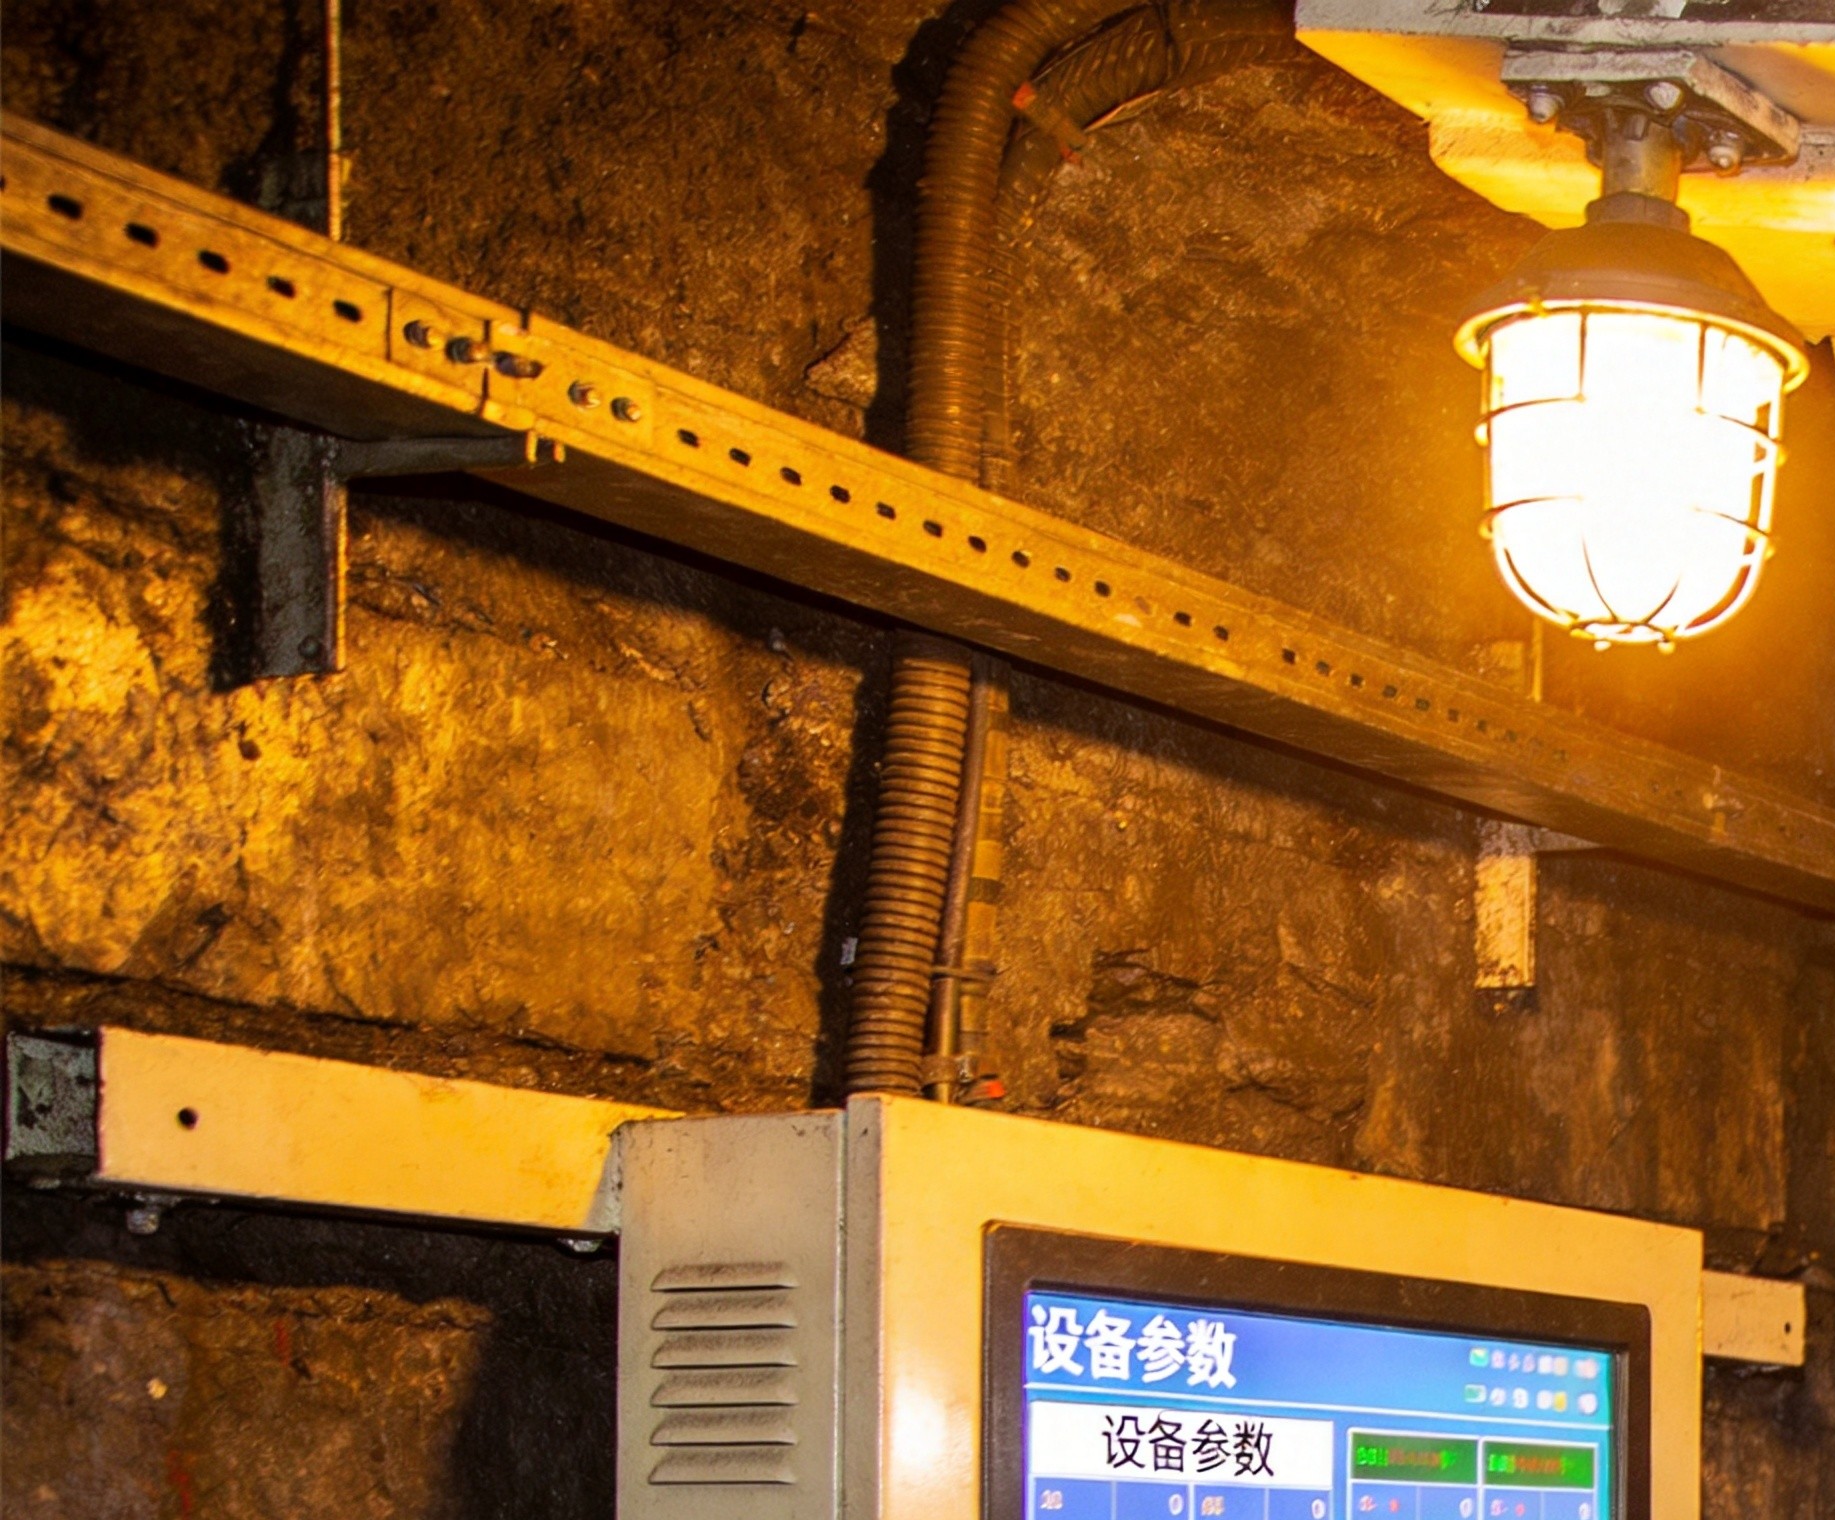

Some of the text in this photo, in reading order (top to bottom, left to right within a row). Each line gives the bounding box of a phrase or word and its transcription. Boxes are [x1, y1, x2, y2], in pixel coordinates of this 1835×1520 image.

[1028, 1304, 1237, 1389] 设备参数
[1102, 1414, 1274, 1477] 设备参数
